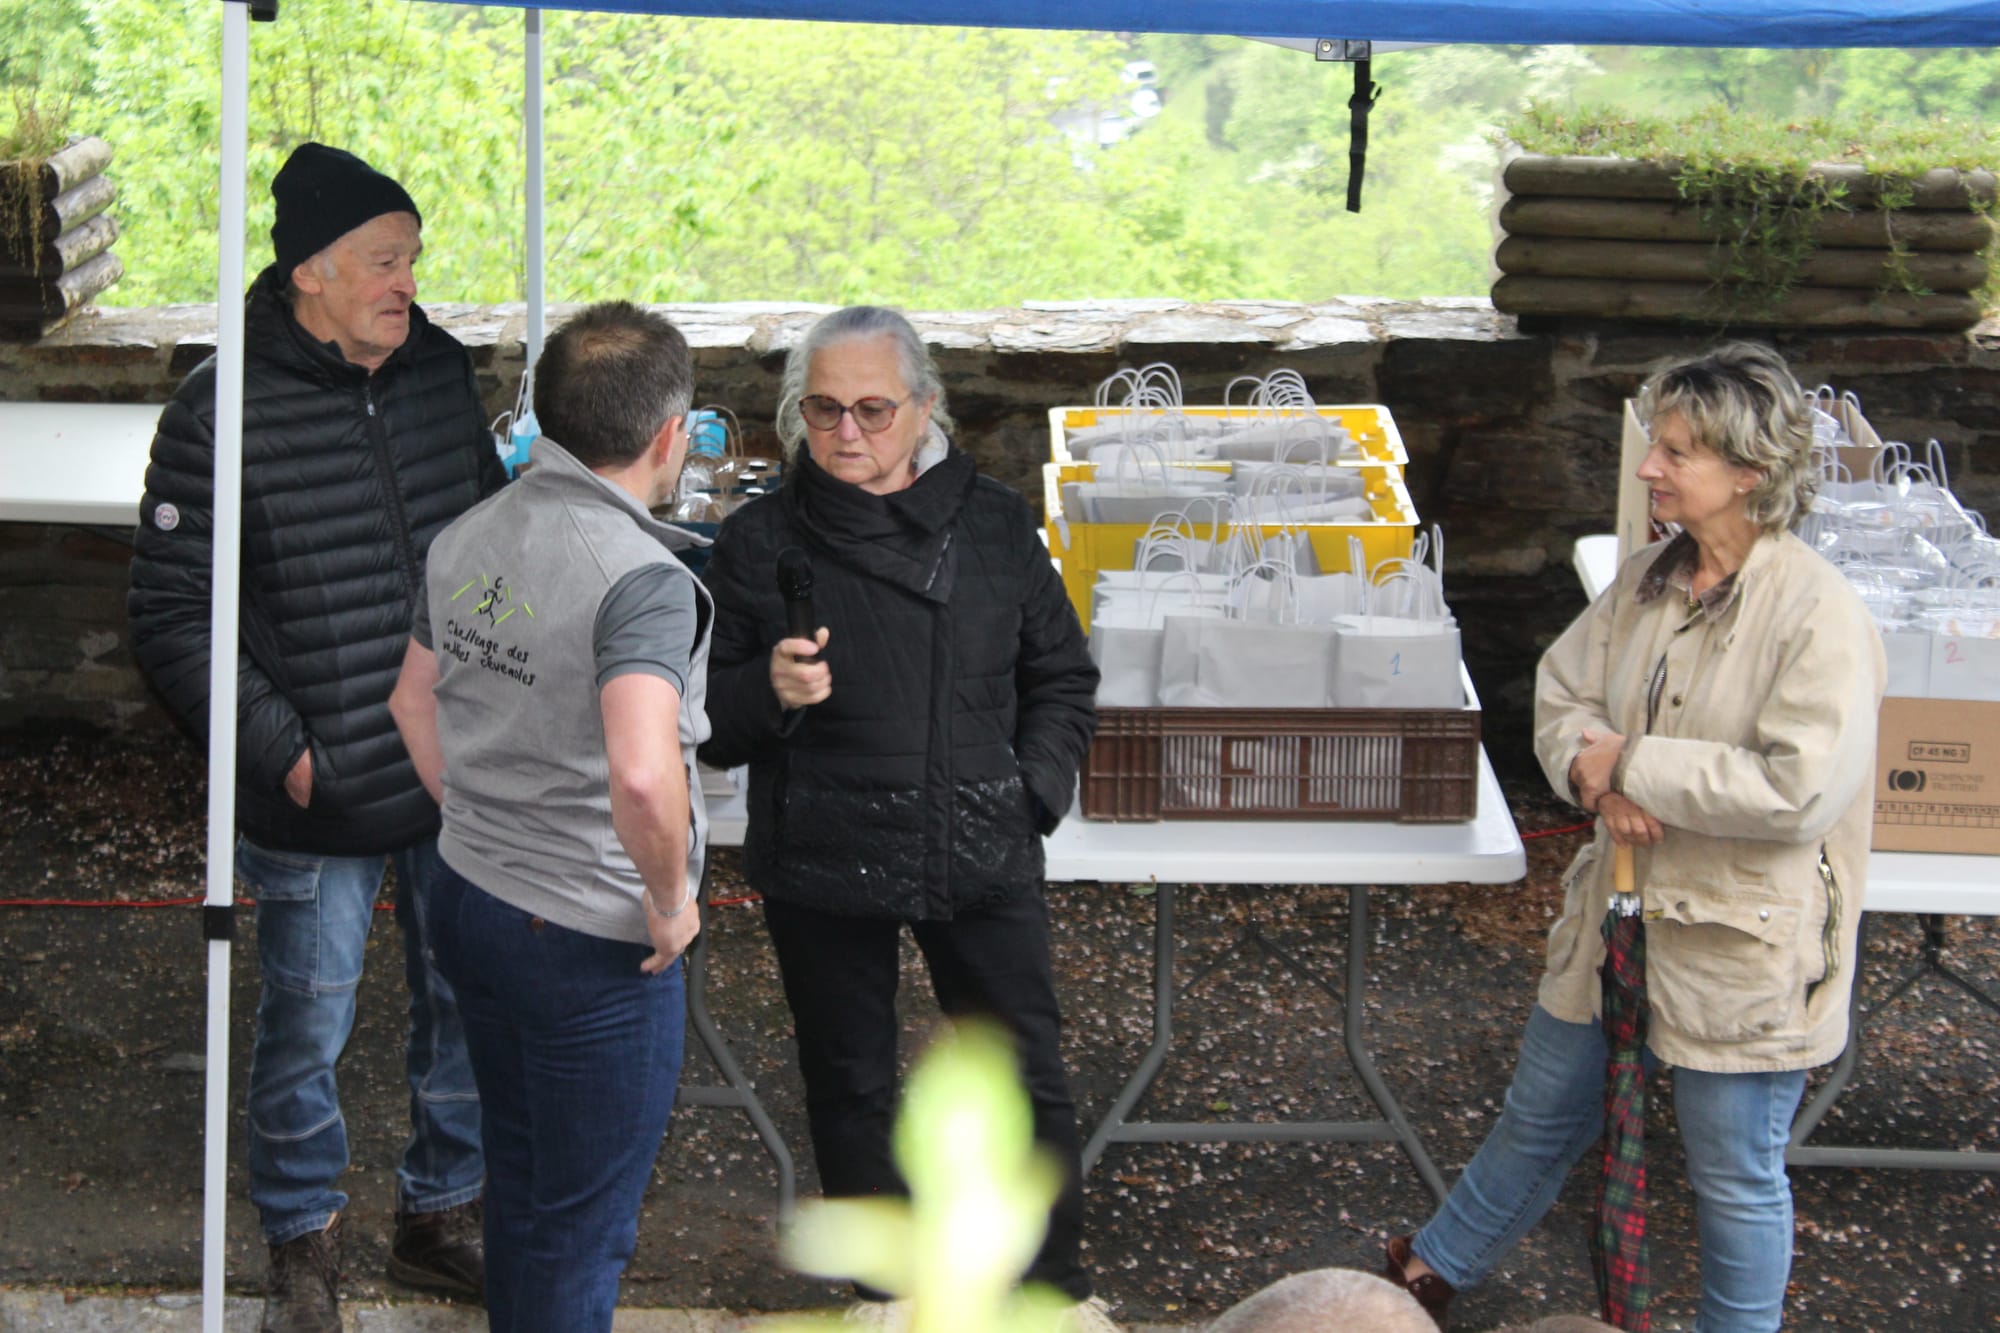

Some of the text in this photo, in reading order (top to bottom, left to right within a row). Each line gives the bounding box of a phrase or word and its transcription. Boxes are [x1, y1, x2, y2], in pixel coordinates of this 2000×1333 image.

[448, 619, 529, 664] Challenge des
[1944, 641, 1966, 664] 2
[1390, 653, 1401, 676] 1
